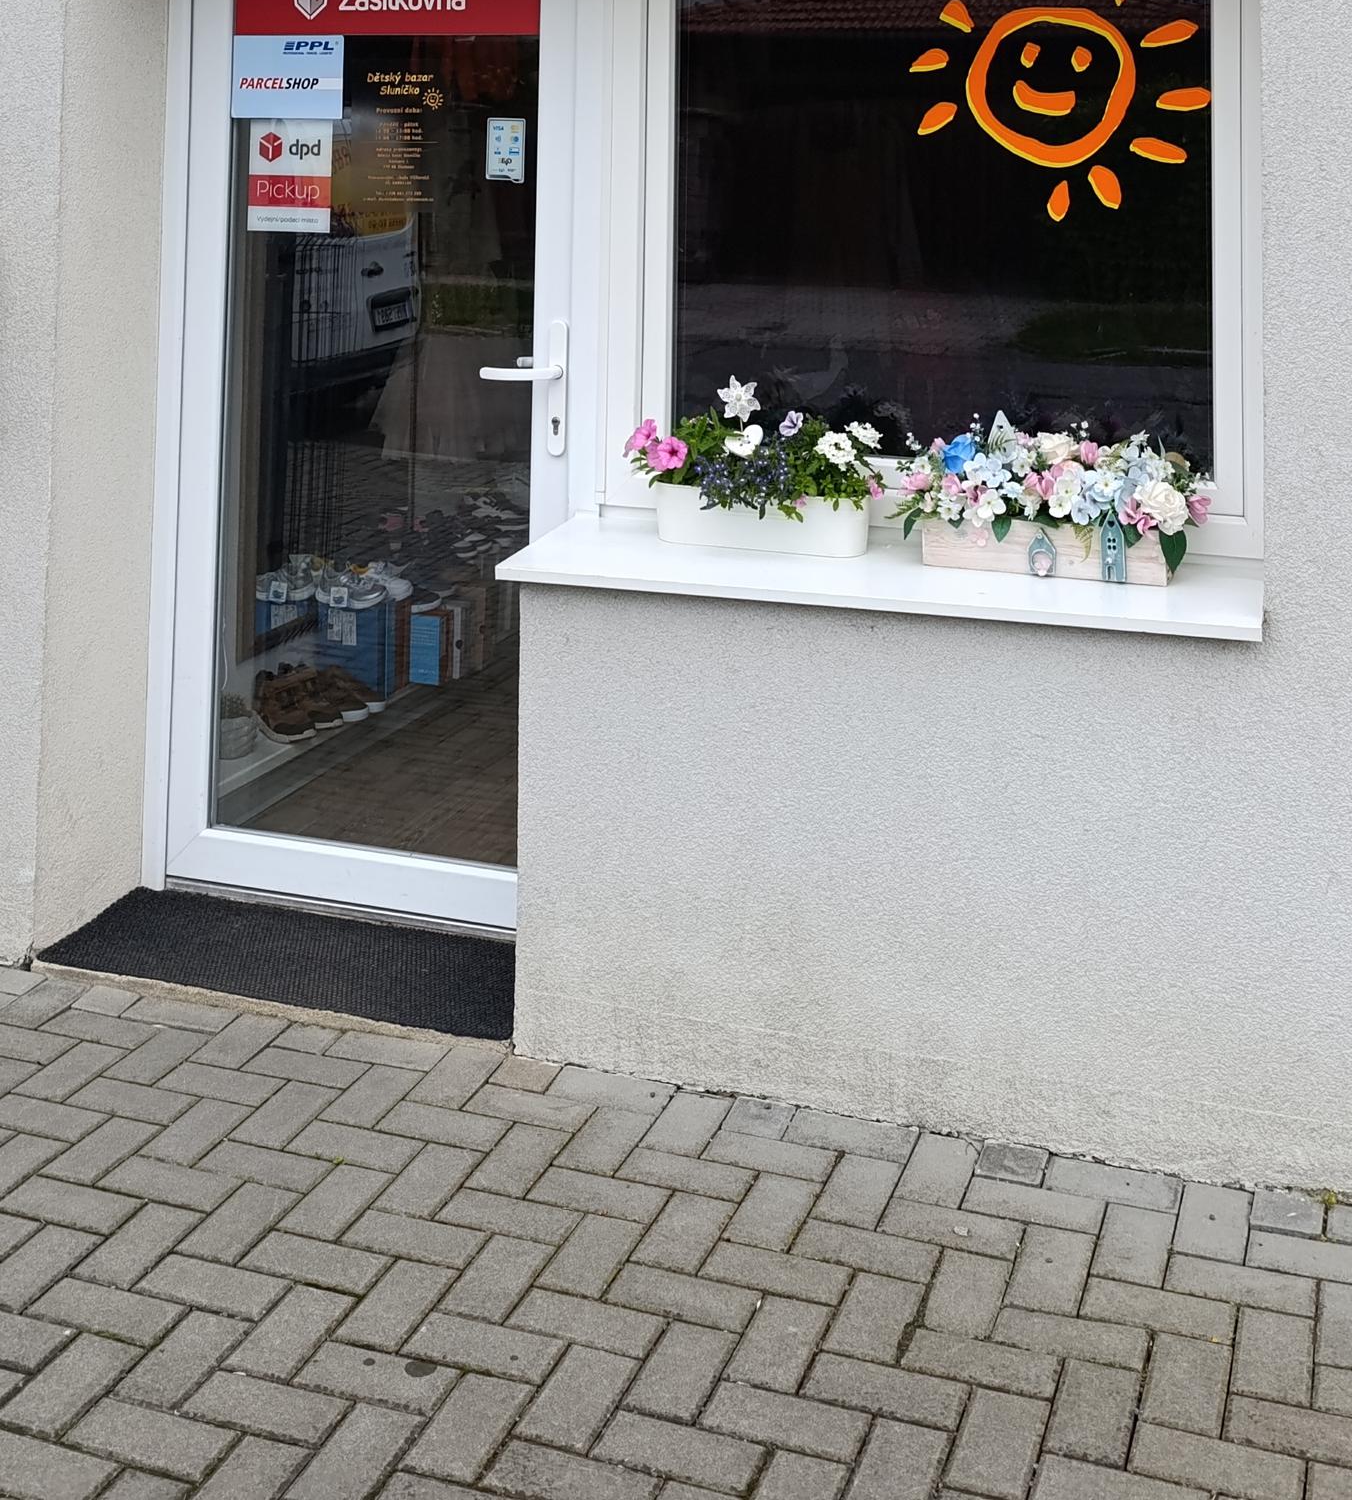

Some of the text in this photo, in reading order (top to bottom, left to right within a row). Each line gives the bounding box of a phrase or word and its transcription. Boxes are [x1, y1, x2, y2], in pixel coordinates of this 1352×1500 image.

[292, 40, 334, 52] PPL
[239, 77, 320, 90] PARCELSHOP
[367, 72, 434, 85] Dětský bazar
[380, 85, 420, 95] Sluníčko
[288, 139, 321, 160] dpd
[256, 180, 320, 202] Pickup
